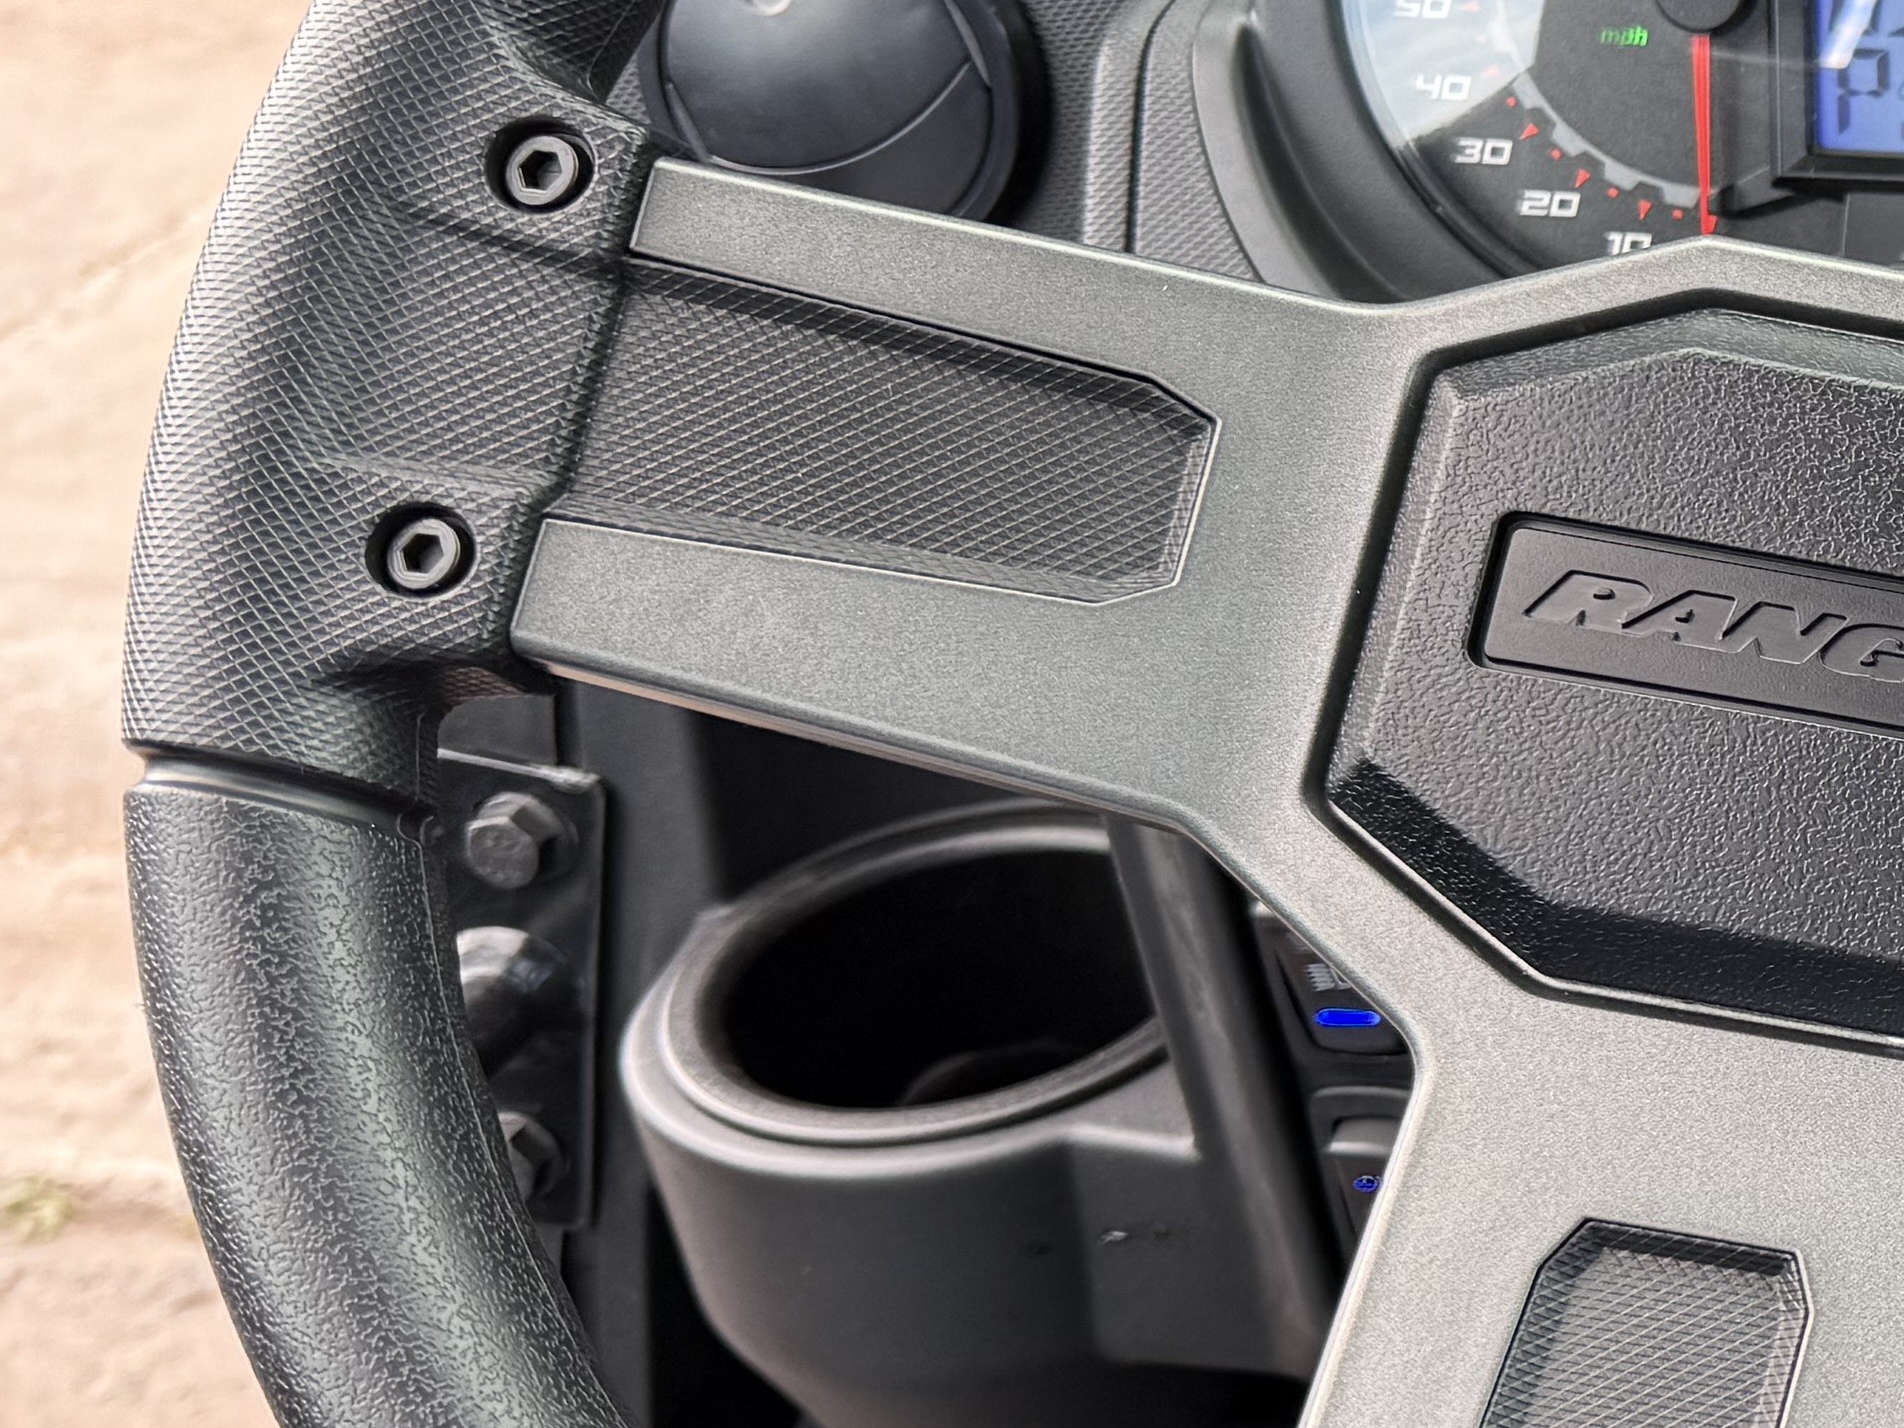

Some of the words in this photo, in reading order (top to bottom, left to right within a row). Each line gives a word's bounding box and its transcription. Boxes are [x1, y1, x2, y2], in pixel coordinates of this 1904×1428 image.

[1600, 24, 1648, 48] mph
[1415, 74, 1471, 101] 40
[1837, 48, 1890, 135] P
[1454, 137, 1513, 165] 30
[1519, 189, 1580, 218] 20
[1603, 230, 1652, 256] 10
